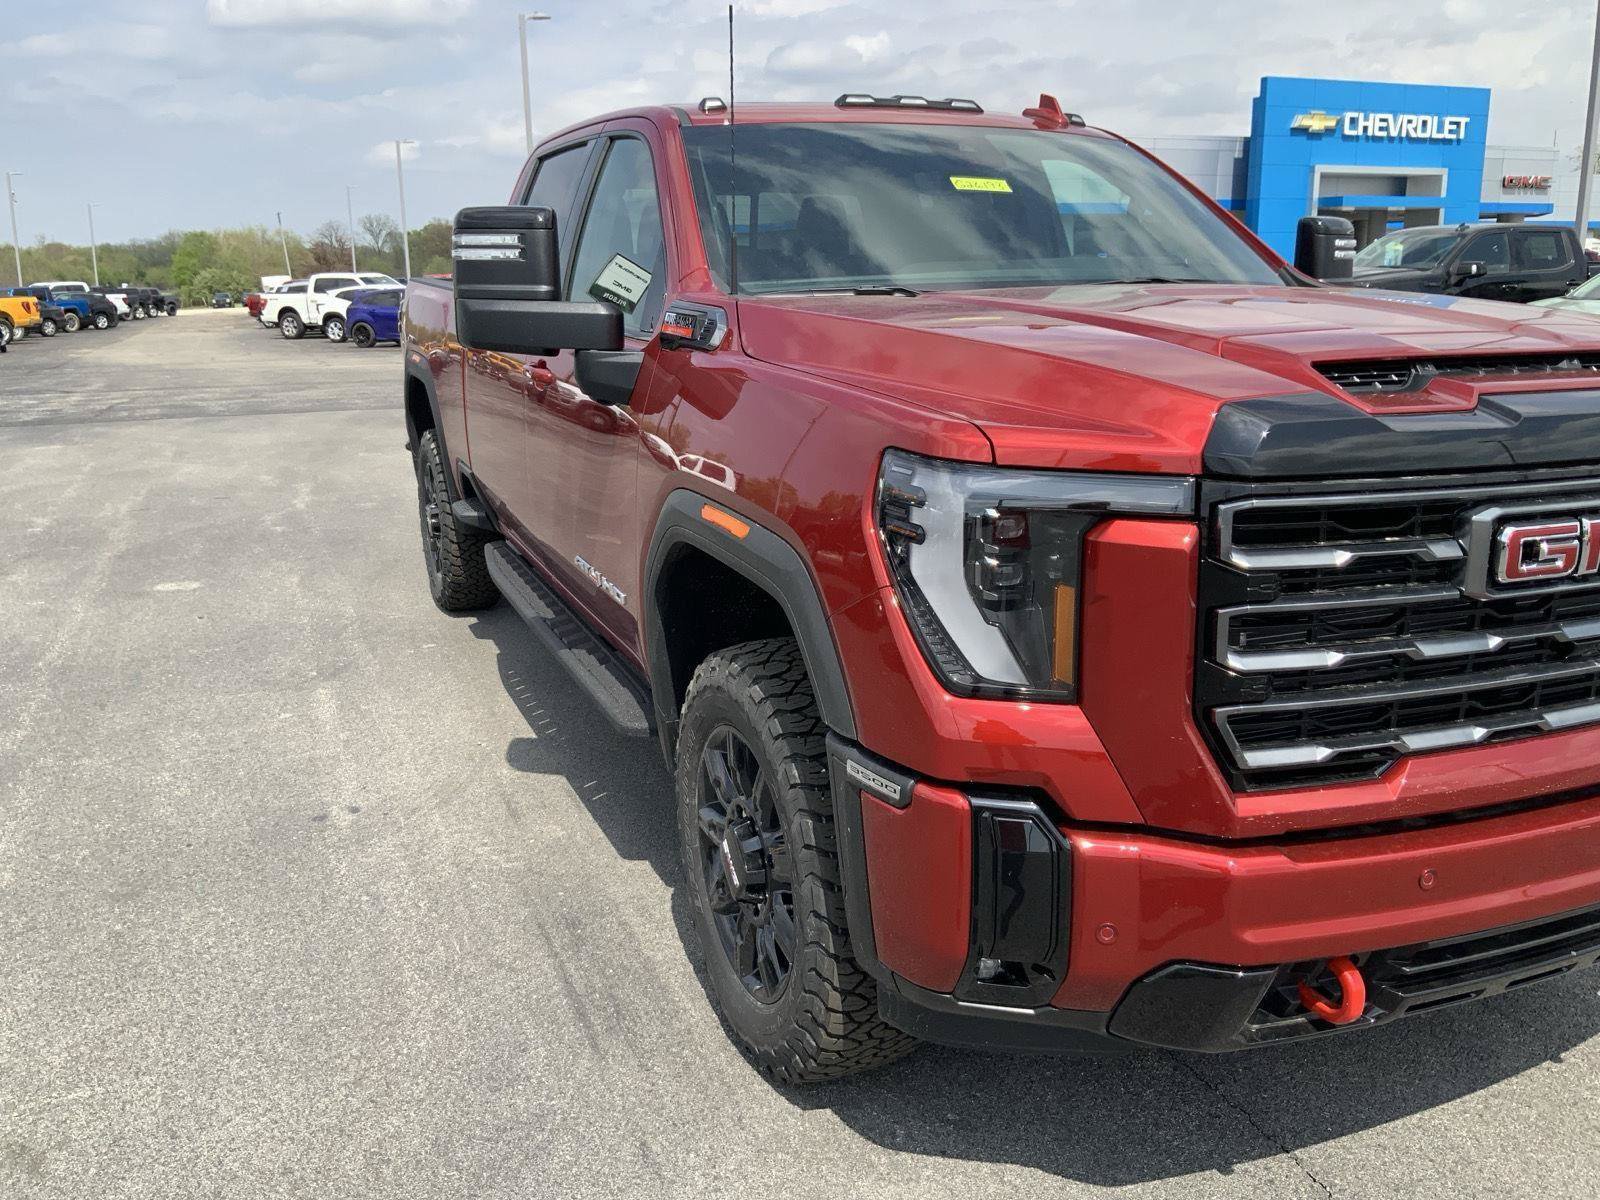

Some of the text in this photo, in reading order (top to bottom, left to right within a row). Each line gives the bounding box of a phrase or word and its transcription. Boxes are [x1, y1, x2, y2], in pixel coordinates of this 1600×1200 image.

[1343, 111, 1470, 139] CHEVROLET
[1503, 175, 1552, 189] GMC
[1497, 518, 1600, 584] G
[849, 764, 898, 795] 3500
